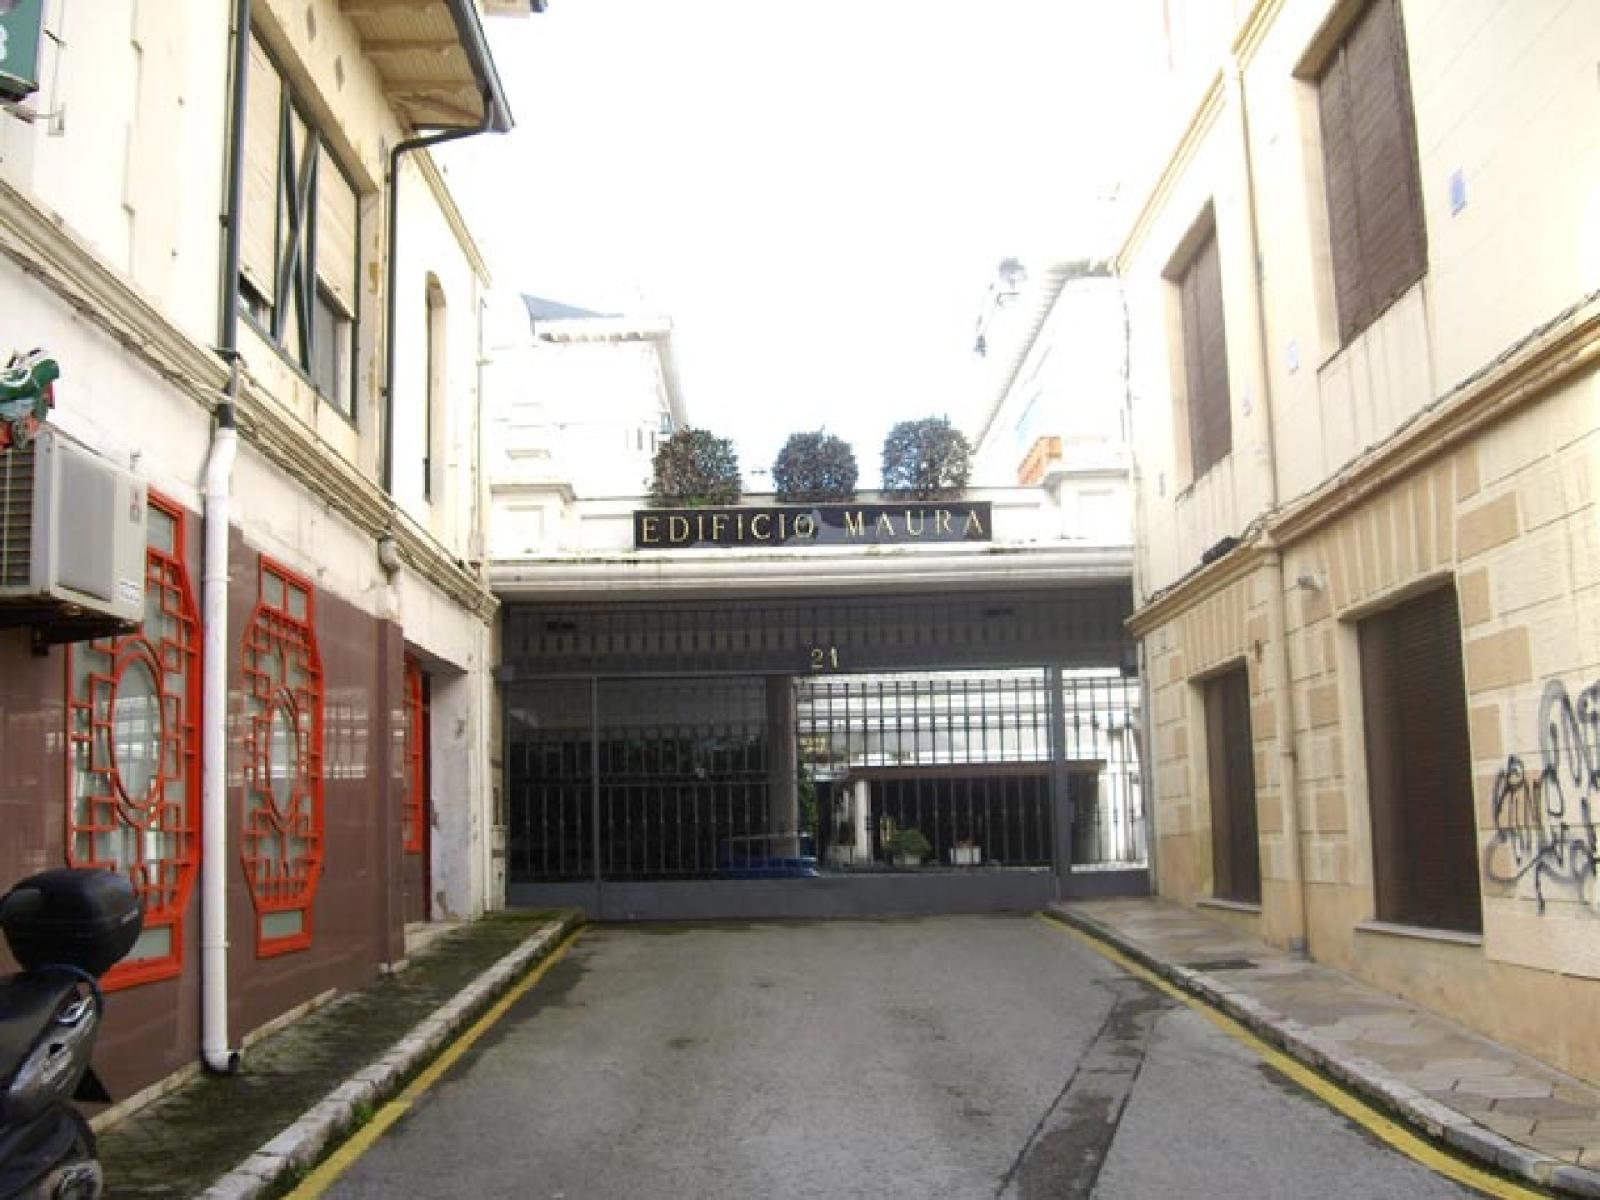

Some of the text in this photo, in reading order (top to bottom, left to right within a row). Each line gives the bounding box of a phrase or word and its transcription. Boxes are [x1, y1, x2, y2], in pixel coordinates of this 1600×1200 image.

[641, 509, 984, 543] EDIFICIO MAURA
[810, 647, 839, 669] 21
